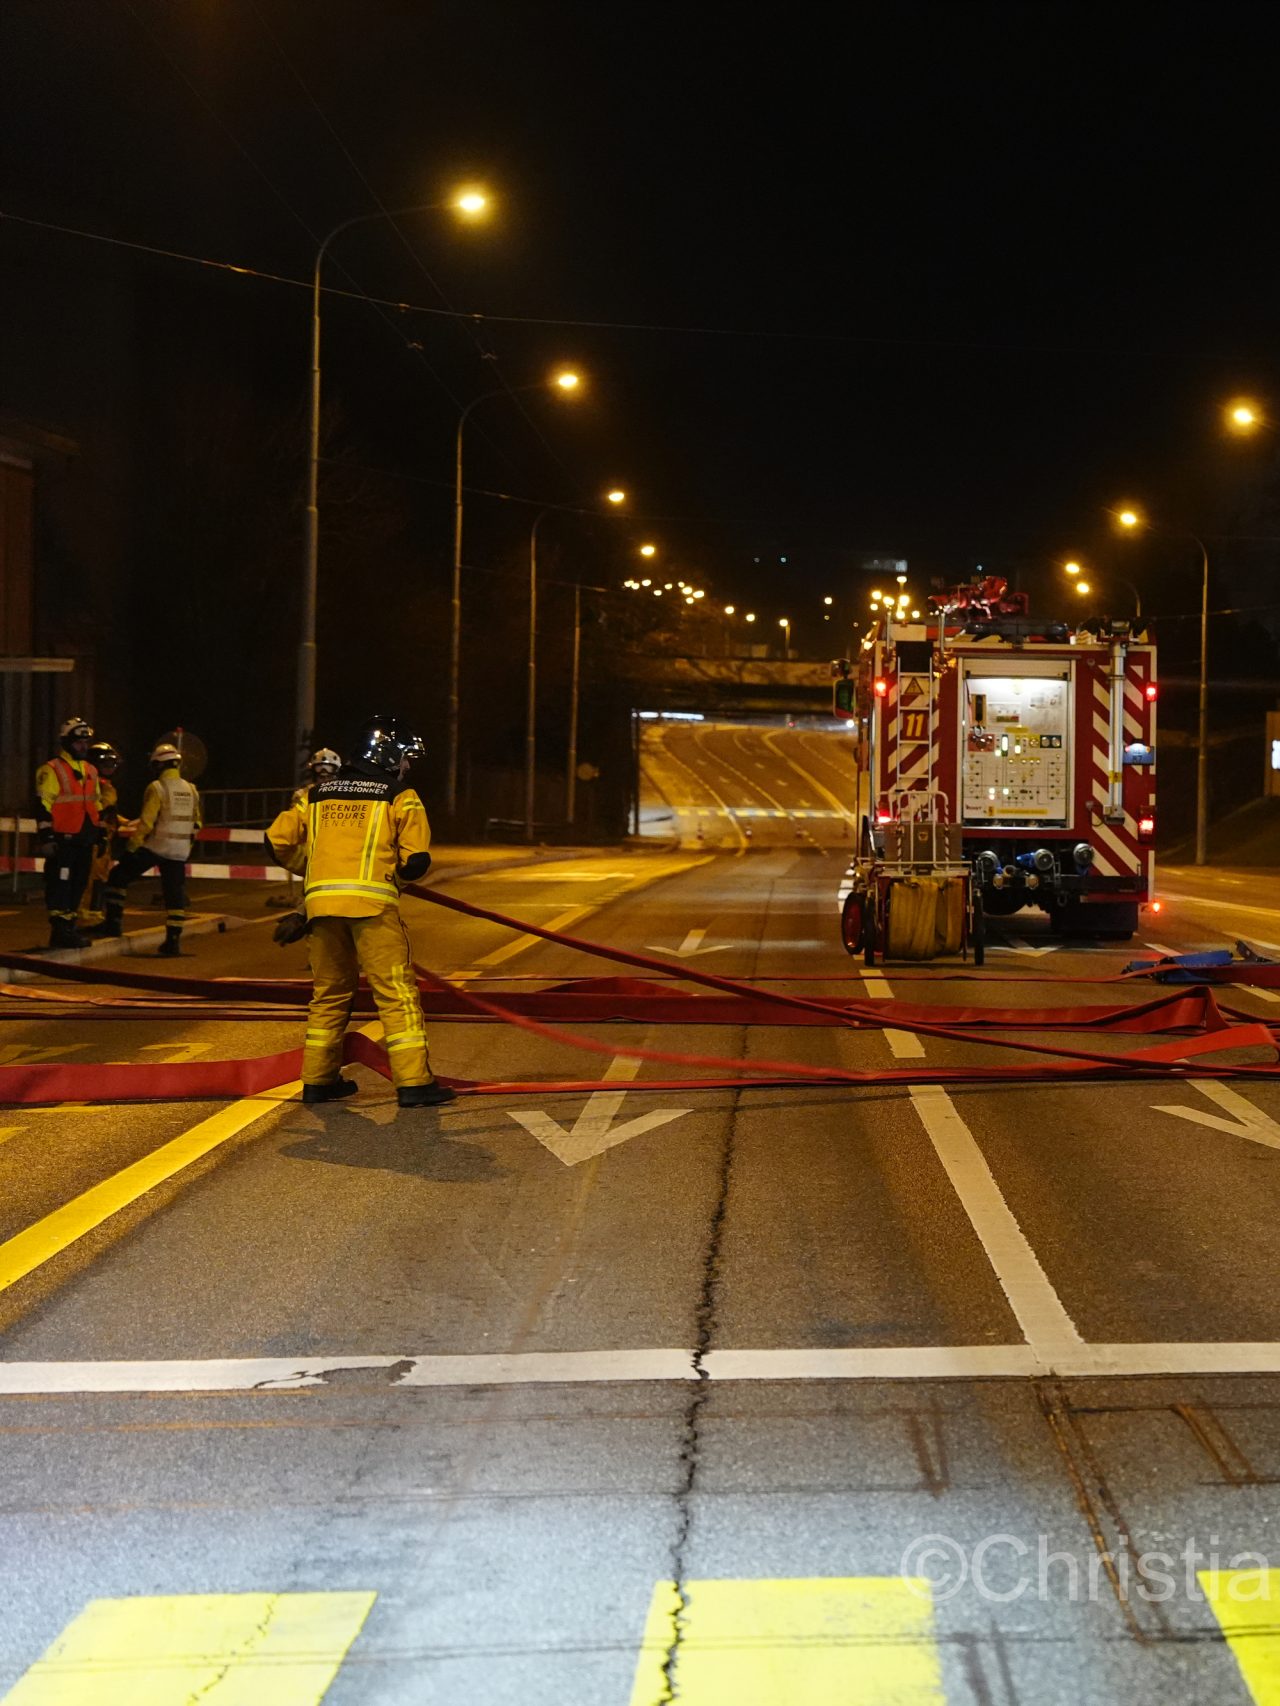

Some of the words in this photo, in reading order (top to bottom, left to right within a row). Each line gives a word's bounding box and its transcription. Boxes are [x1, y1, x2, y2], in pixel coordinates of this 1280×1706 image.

[905, 713, 925, 737] 11
[318, 786, 385, 795] PROFESSIONNEL
[322, 803, 368, 813] INCENDIE
[321, 812, 366, 820] SECOURS
